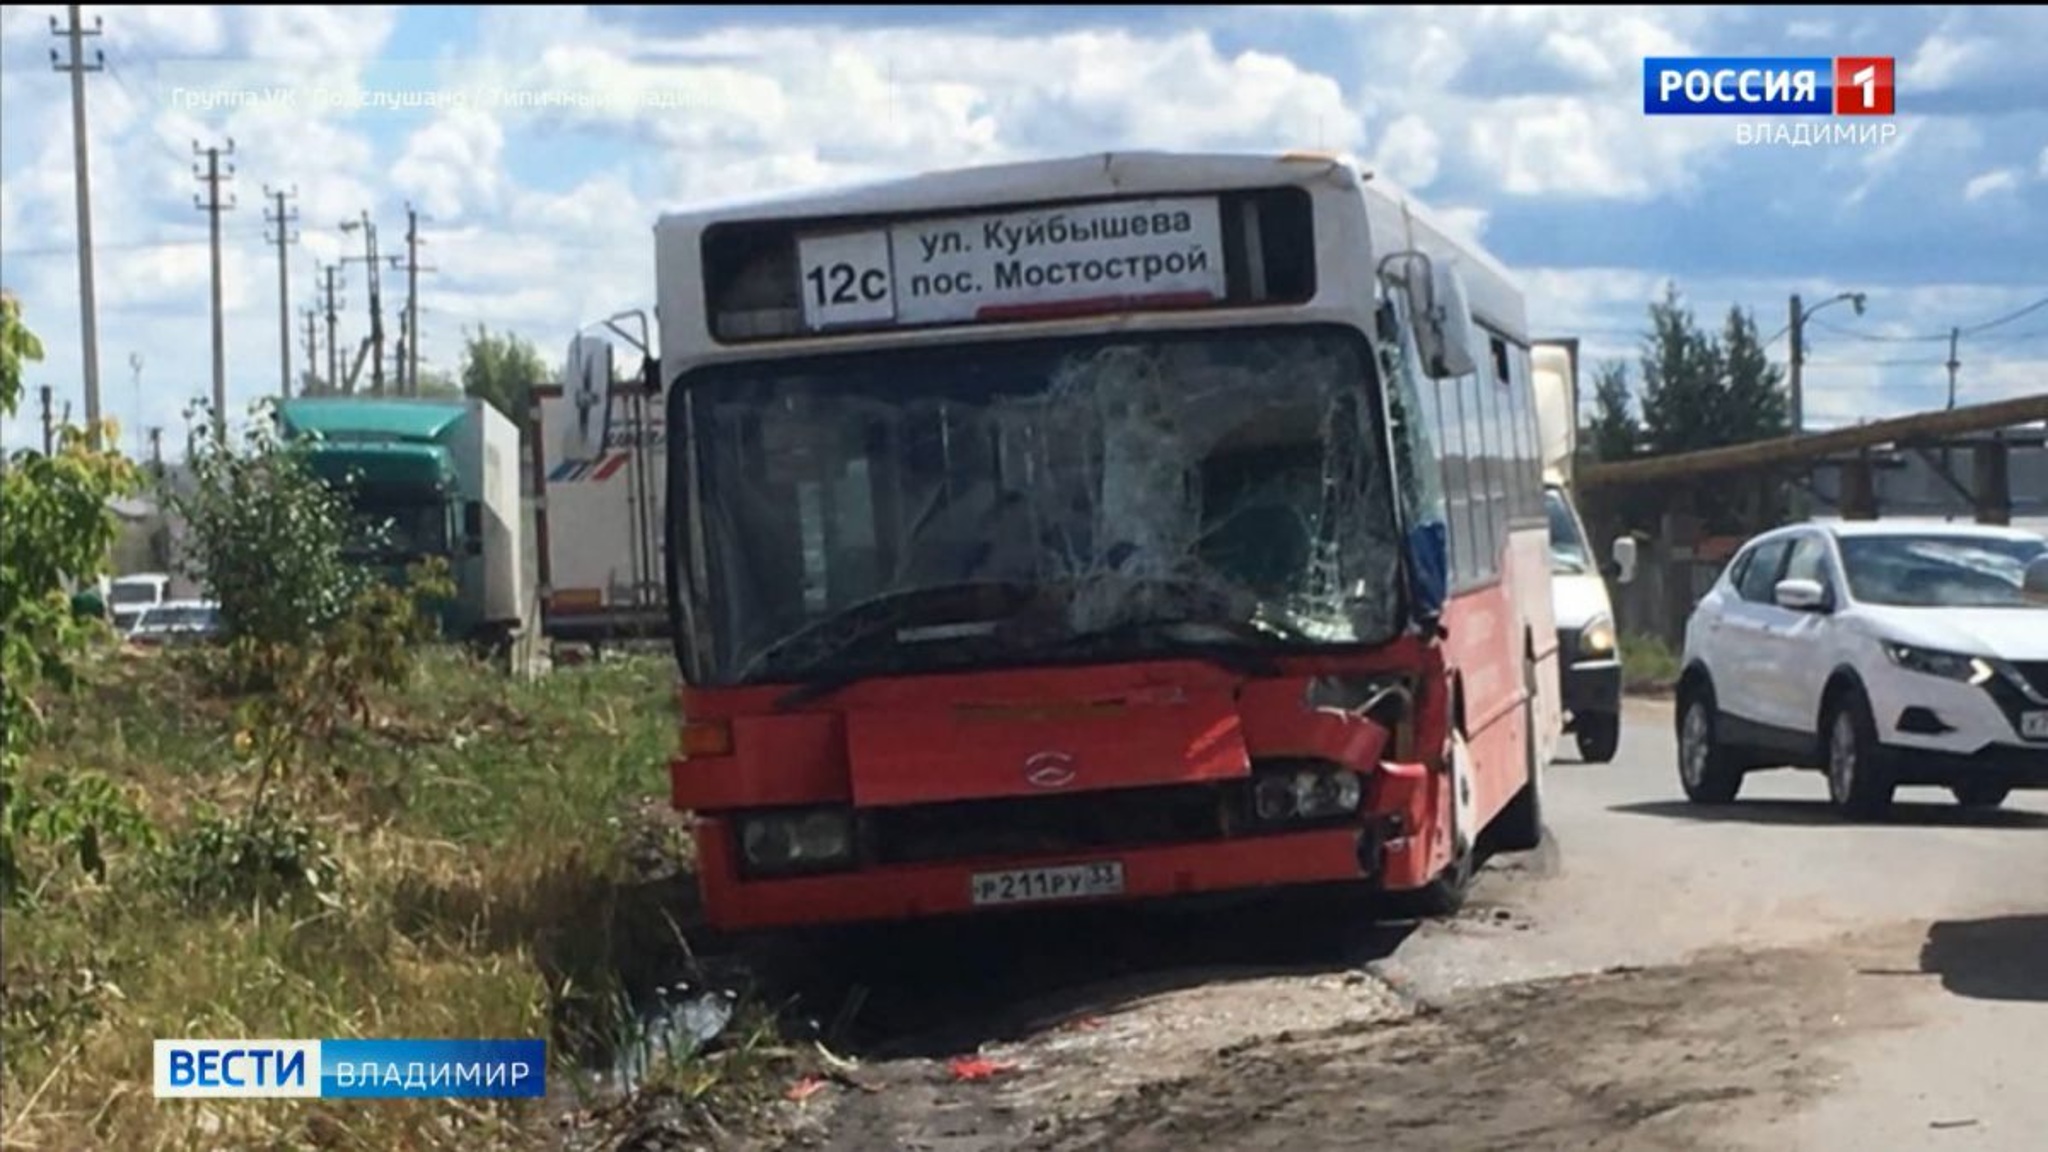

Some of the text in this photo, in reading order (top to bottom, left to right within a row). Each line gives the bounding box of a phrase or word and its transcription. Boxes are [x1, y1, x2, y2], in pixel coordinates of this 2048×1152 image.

[919, 209, 1192, 261] ул. Куйбышева
[911, 245, 1208, 297] пос. Мостострой
